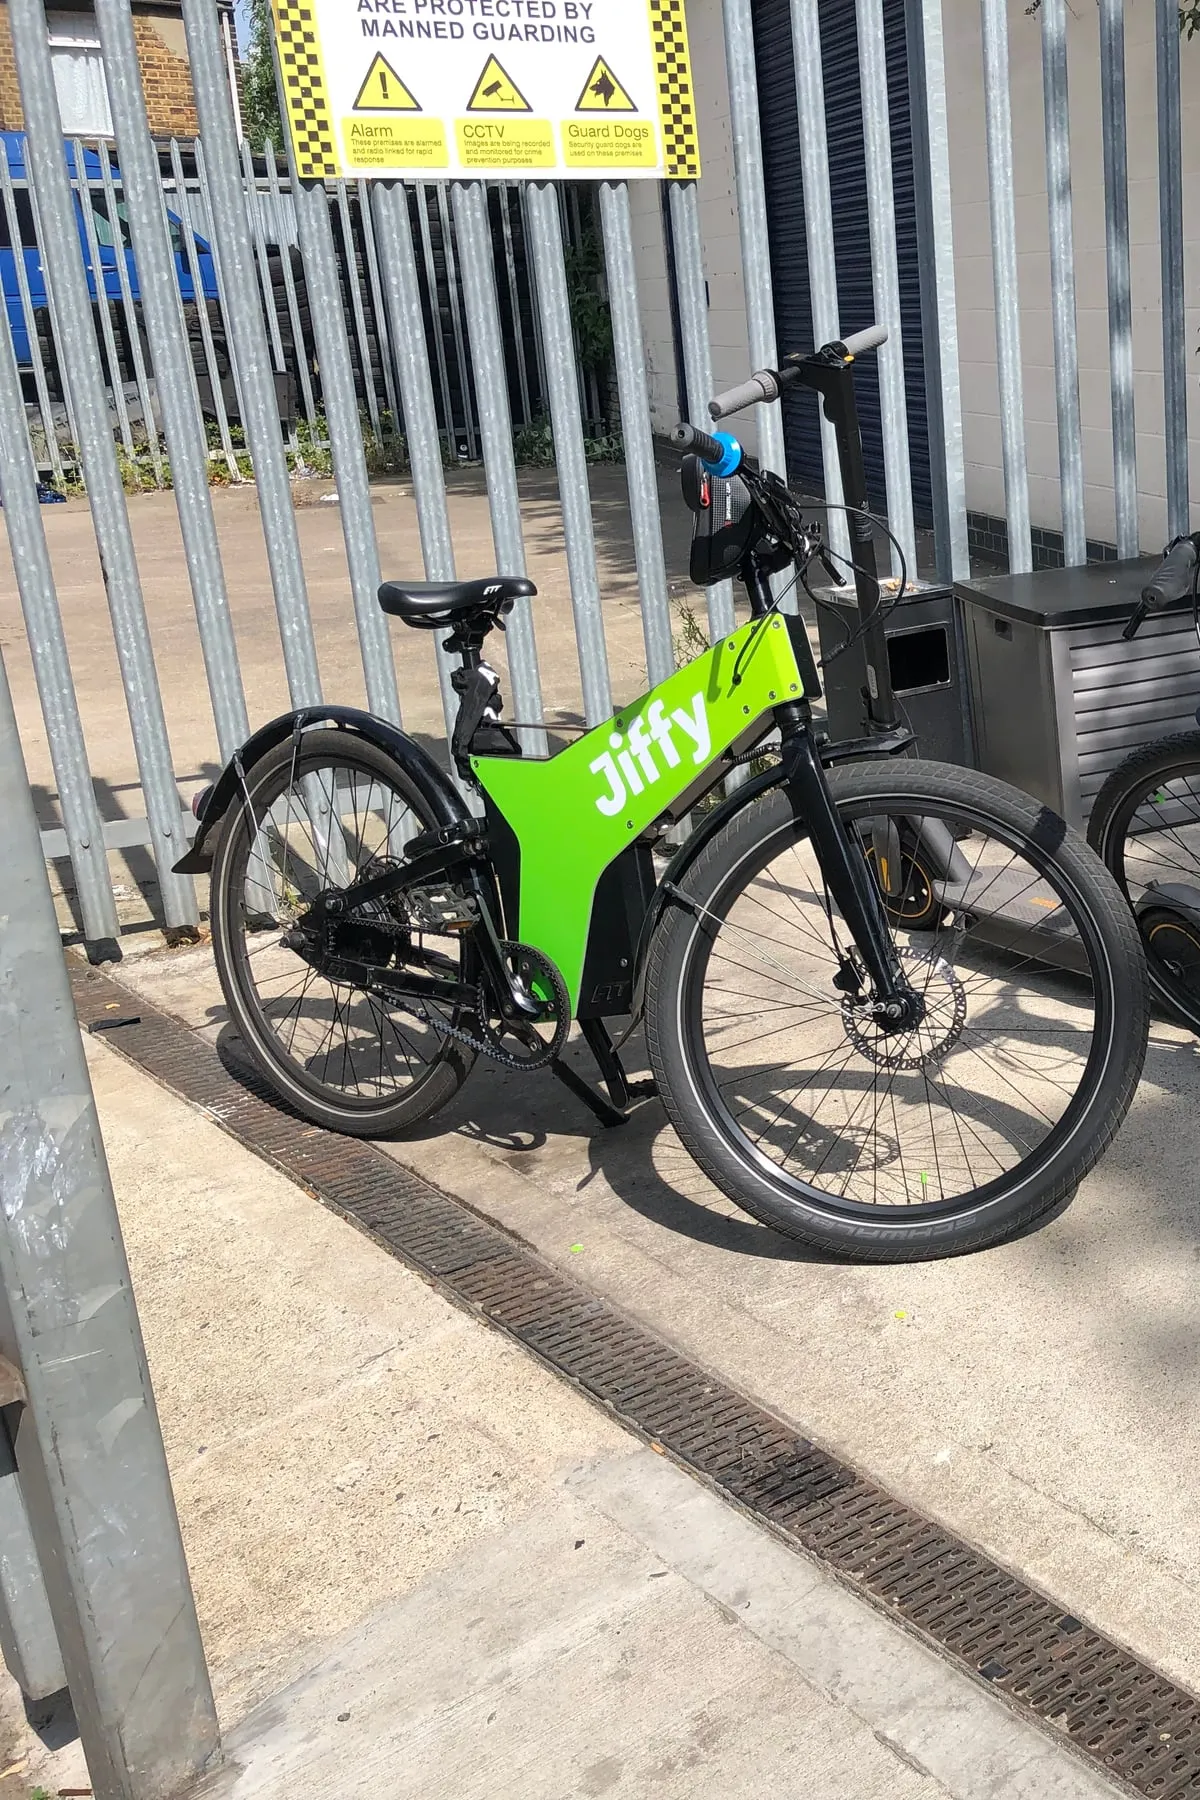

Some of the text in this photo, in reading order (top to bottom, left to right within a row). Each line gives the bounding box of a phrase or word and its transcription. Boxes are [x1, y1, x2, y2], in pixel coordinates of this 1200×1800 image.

[357, 0, 593, 20] ARE PROTECTED BY
[361, 19, 595, 43] MANNED GUARDING
[351, 123, 393, 137] Alarm
[463, 124, 505, 138] CCTV
[568, 124, 649, 141] Guard Dogs
[373, 139, 402, 147] premises
[502, 140, 520, 148] being
[568, 141, 594, 149] Security
[595, 141, 613, 149] guard
[615, 141, 631, 149] dogs
[416, 148, 433, 156] rapid
[615, 150, 643, 158] premises
[588, 691, 712, 816] Jiffy
[791, 1207, 977, 1241] SCHWALBE
